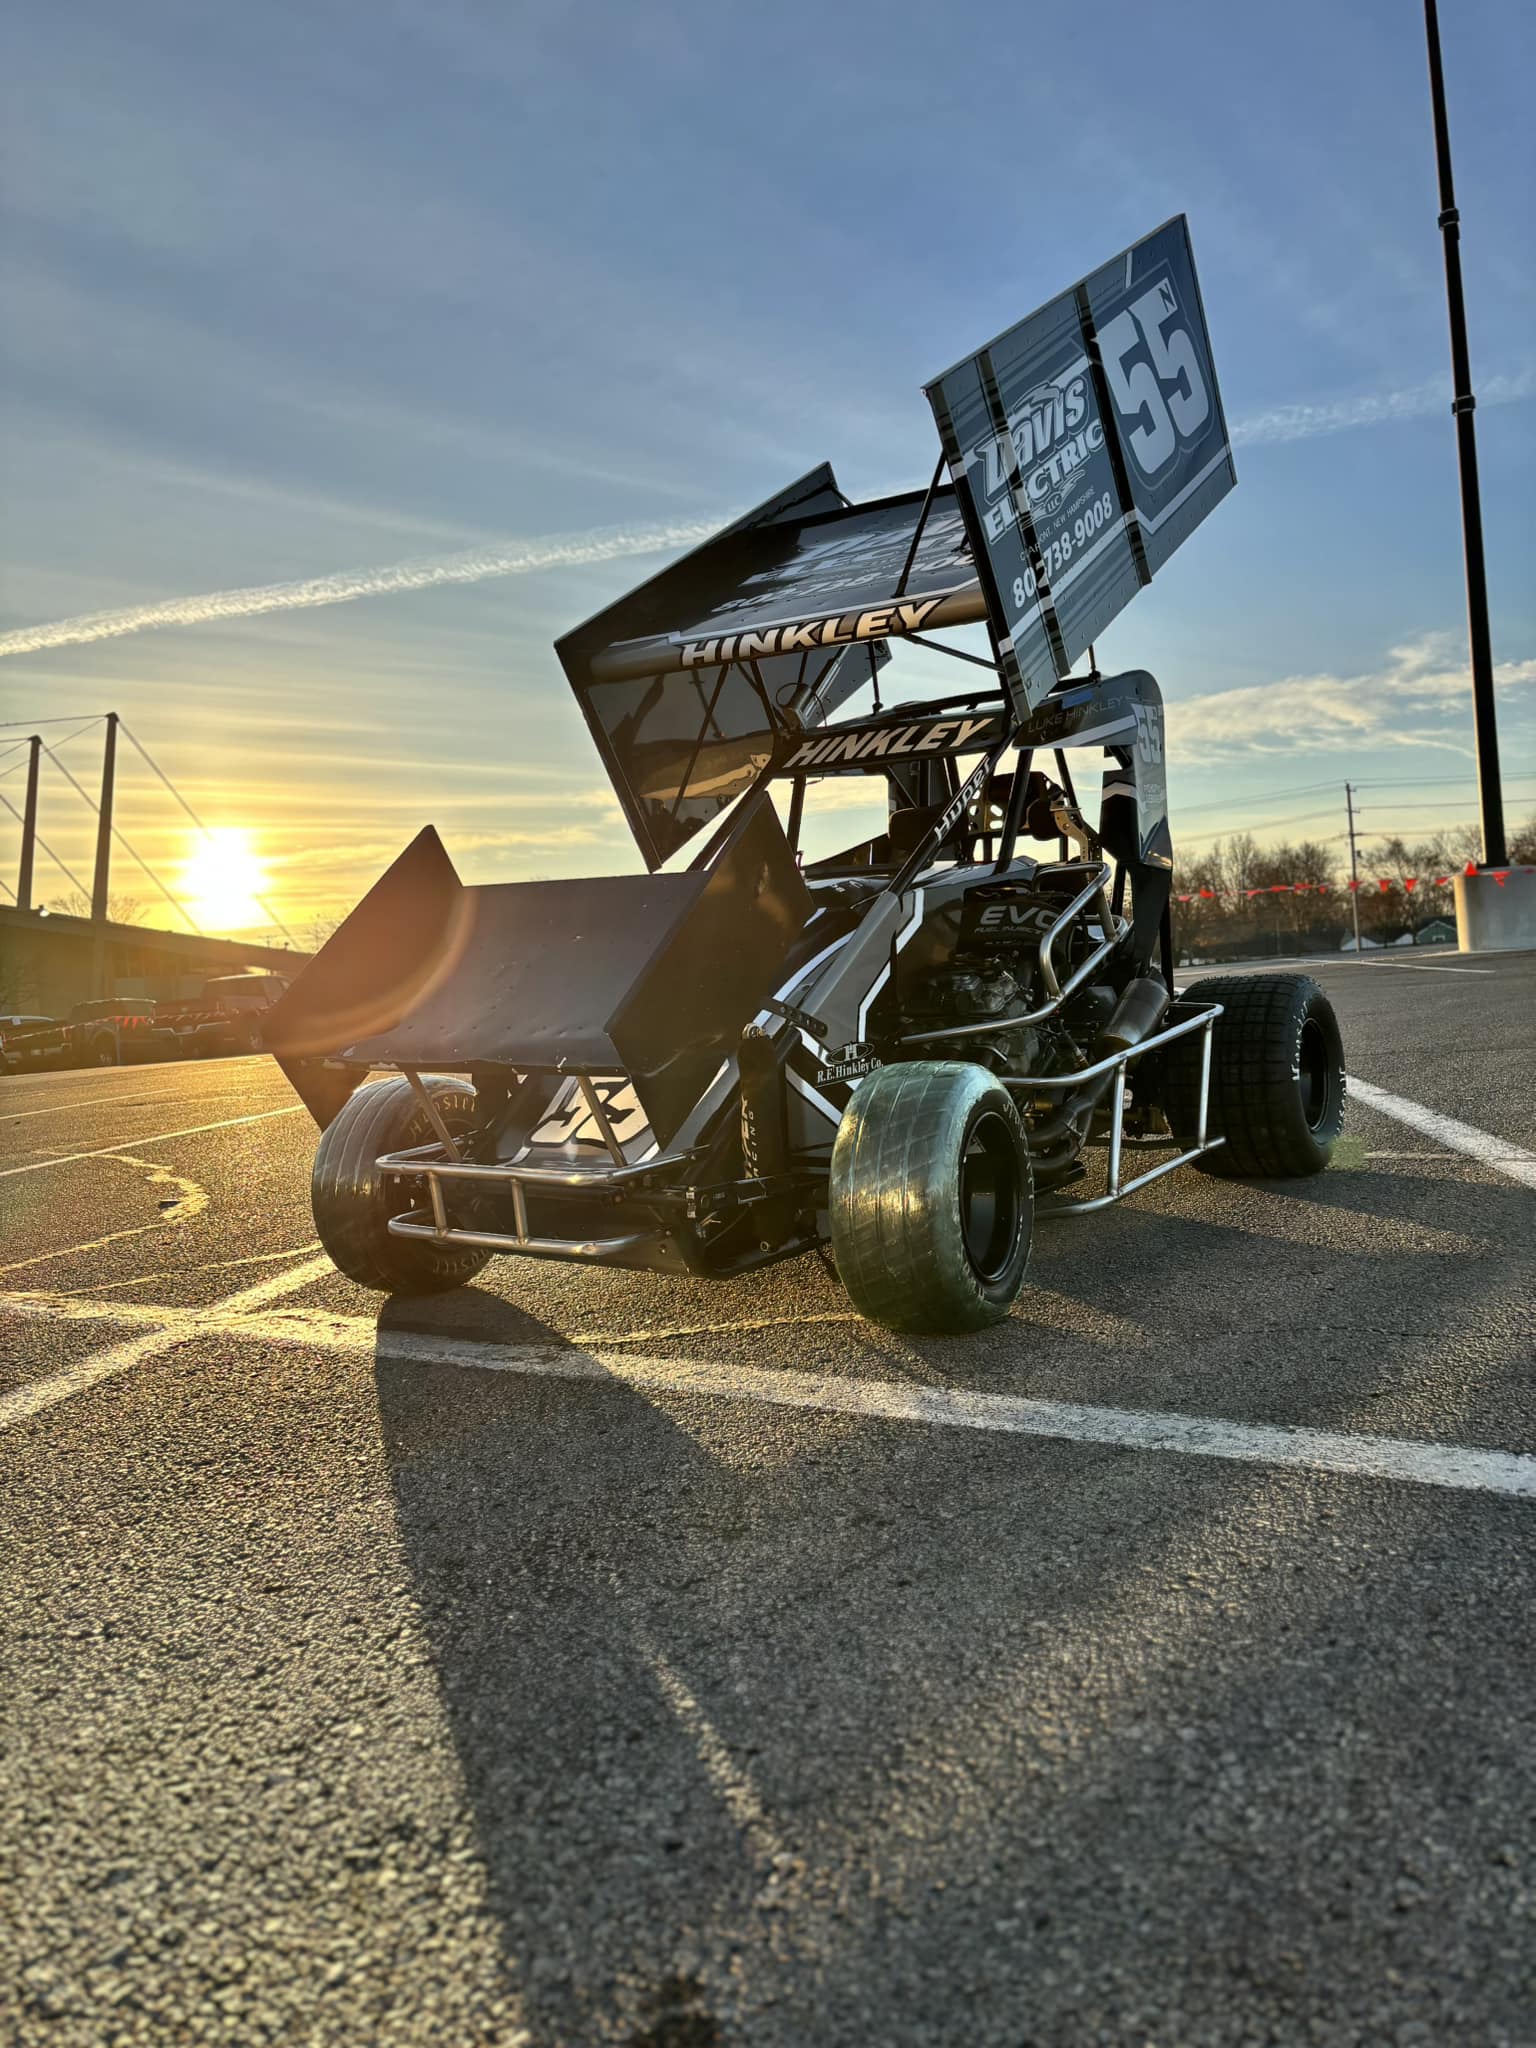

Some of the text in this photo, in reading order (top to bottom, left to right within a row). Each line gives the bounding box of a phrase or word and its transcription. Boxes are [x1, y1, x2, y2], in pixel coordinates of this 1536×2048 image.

[1091, 277, 1207, 475] 55
[1013, 491, 1113, 609] 802738-9008
[681, 598, 947, 666] HINKLEY
[783, 717, 995, 769] HINKLEY
